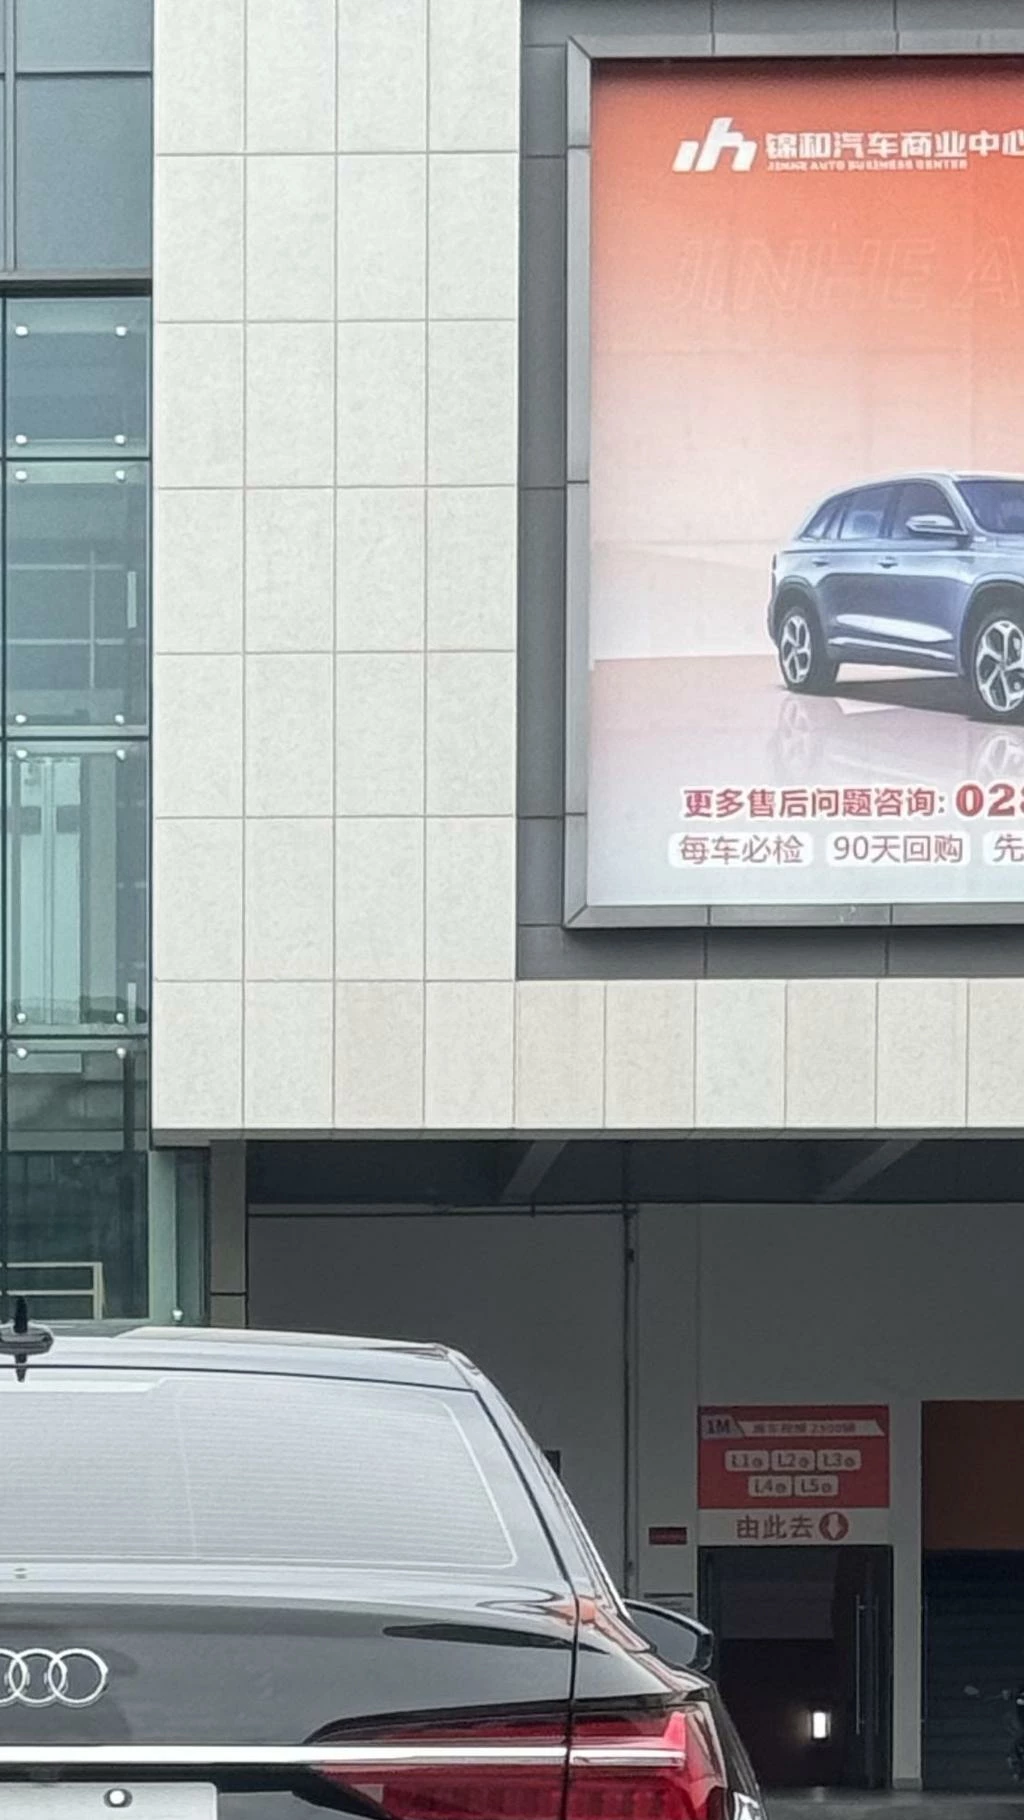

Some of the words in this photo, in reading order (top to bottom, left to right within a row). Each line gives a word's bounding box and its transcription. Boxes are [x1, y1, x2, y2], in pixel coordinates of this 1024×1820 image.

[955, 783, 1024, 817] 02
[679, 834, 805, 865] 每车必检
[833, 834, 964, 864] 90天回购
[736, 1514, 814, 1540] 由此去
